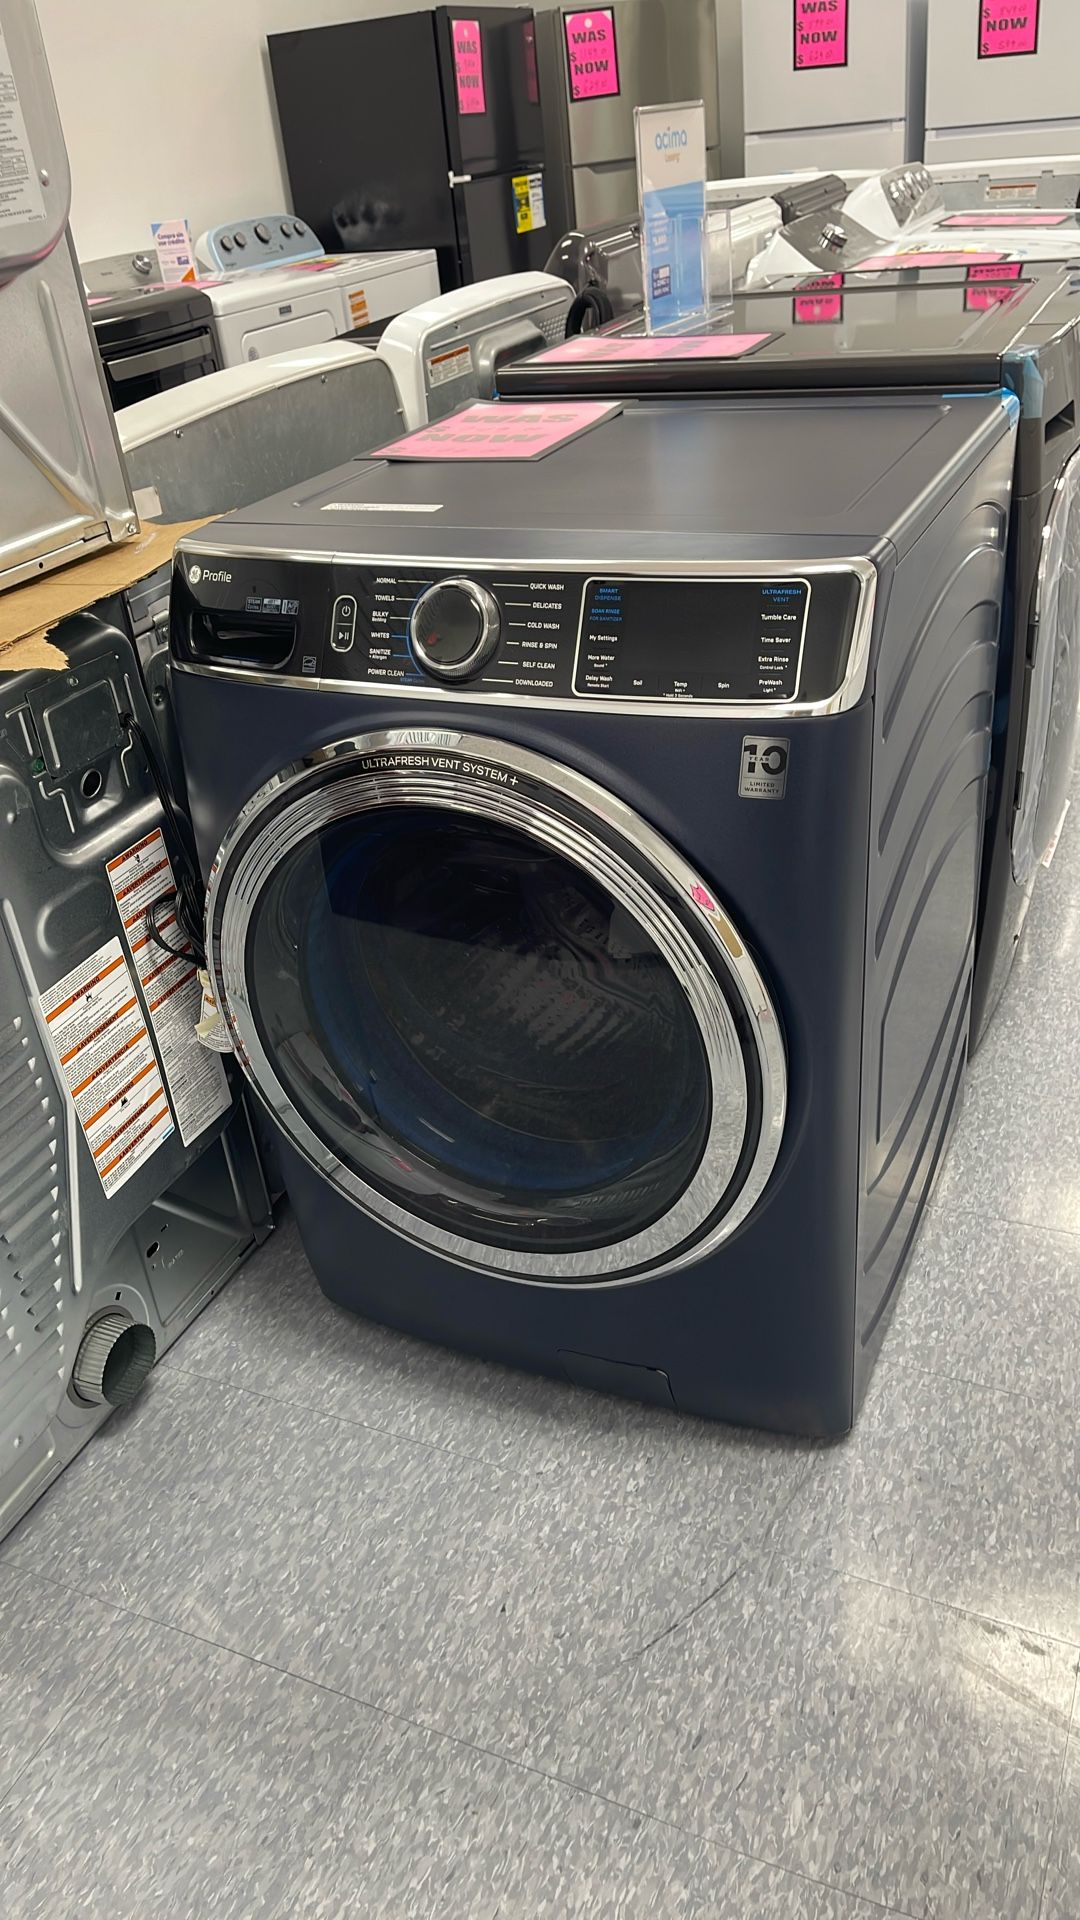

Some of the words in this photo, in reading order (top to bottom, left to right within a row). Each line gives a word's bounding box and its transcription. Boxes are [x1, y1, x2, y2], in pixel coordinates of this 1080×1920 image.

[801, 0, 838, 14] WAS
[986, 16, 1028, 32] NOW
[572, 29, 606, 44] WAS
[800, 30, 837, 45] NOW
[456, 40, 478, 54] WAS
[574, 60, 609, 76] NOW
[459, 75, 480, 89] NOW
[655, 126, 688, 150] acima
[460, 414, 578, 424] WAS
[415, 433, 548, 443] NOW
[202, 569, 232, 583] Profile
[376, 577, 397, 585] NORMAL
[375, 594, 395, 602] TOWELS
[532, 601, 562, 610] DELICATES
[527, 621, 542, 629] COLD
[370, 631, 390, 639] WHITES
[589, 634, 597, 642] My
[597, 634, 618, 642] Settings
[367, 668, 387, 676] POWER
[585, 674, 599, 682] Delay
[515, 678, 554, 687] DOWNLOADED
[744, 744, 788, 776] 10
[361, 756, 430, 770] ULTRAFRESH
[431, 757, 461, 770] VENT
[462, 762, 508, 783] SYSTEM
[509, 775, 519, 787] +
[75, 975, 101, 998] WARNING
[79, 1010, 120, 1049] AVERTISSEMENT
[95, 1043, 130, 1077] ADVERTENCIA
